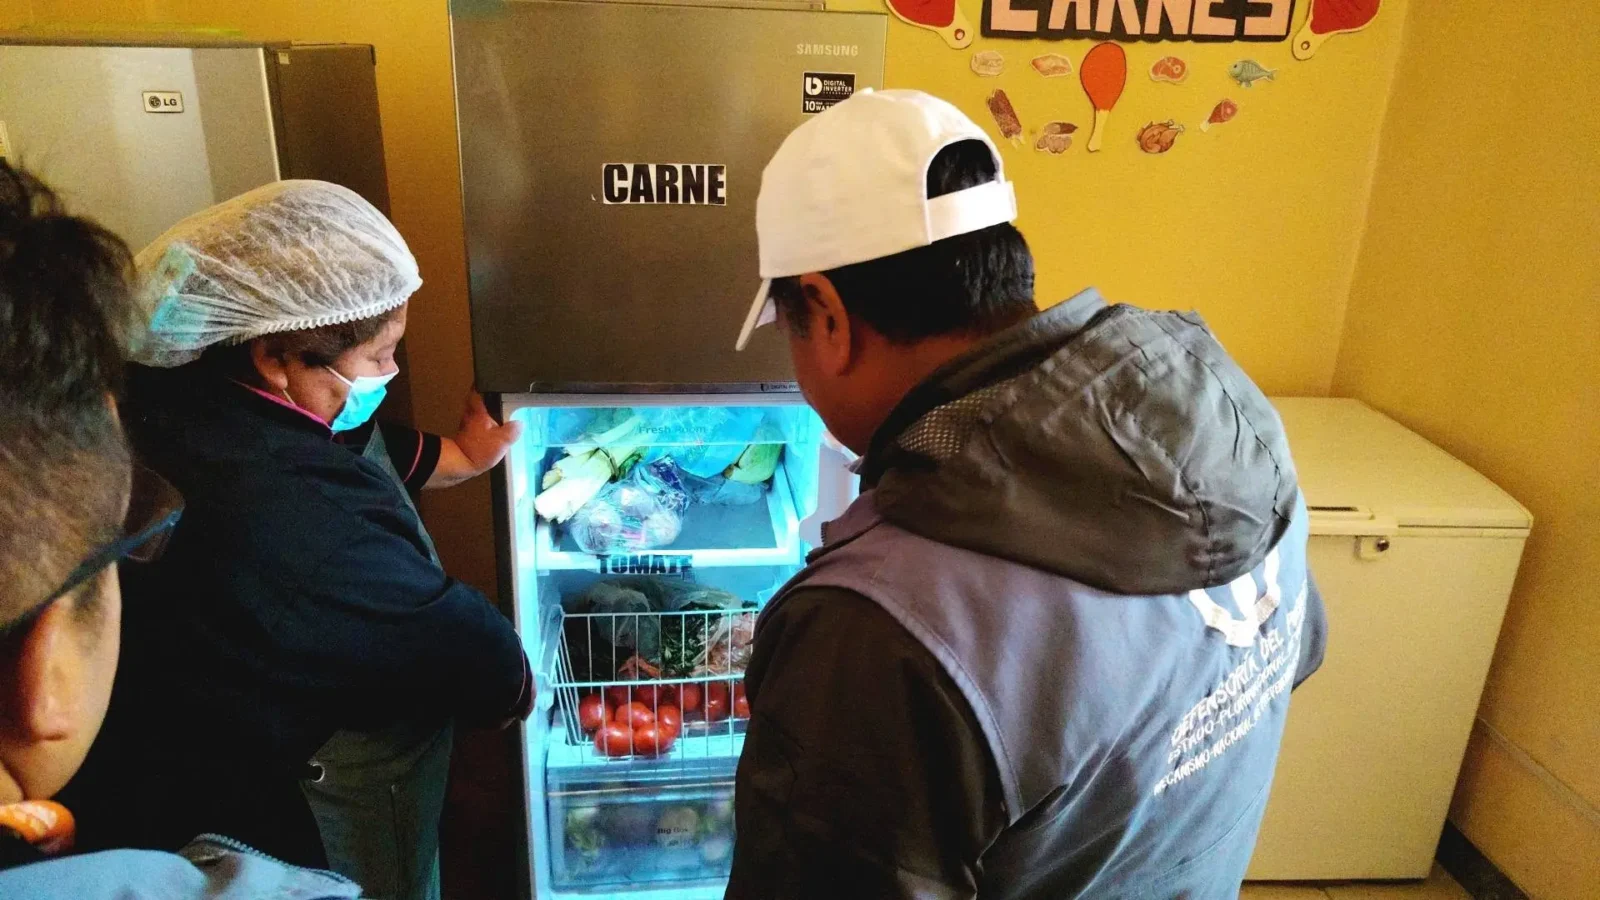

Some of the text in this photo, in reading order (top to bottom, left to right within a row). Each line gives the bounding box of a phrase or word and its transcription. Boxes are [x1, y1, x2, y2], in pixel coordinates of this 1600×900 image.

[796, 43, 858, 57] SAMSUNG
[805, 101, 816, 112] 10
[603, 163, 726, 205] CARNE
[639, 425, 671, 434] Fresh
